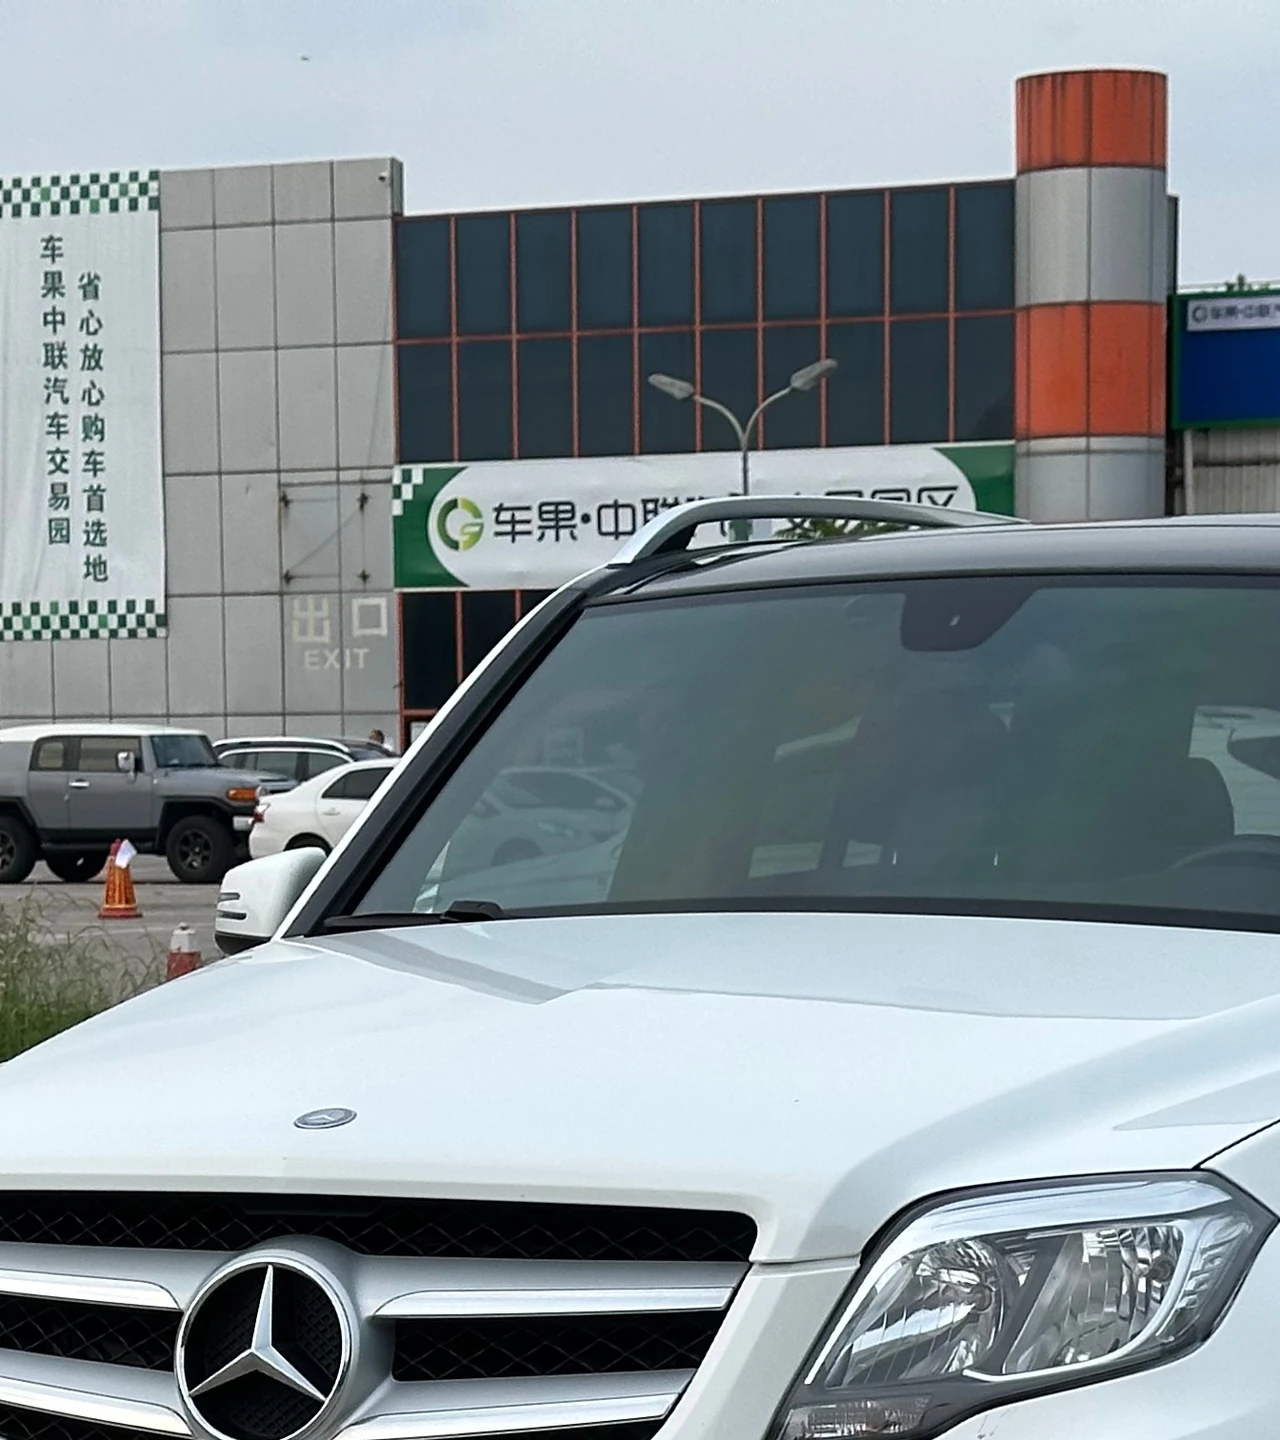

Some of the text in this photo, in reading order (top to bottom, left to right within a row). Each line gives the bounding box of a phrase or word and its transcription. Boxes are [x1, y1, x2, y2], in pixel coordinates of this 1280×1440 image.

[40, 234, 70, 546] 车果中联汽车交易园
[77, 271, 110, 583] 省心放心购车首选地
[292, 596, 388, 642] 出口
[304, 647, 370, 669] EXIT
